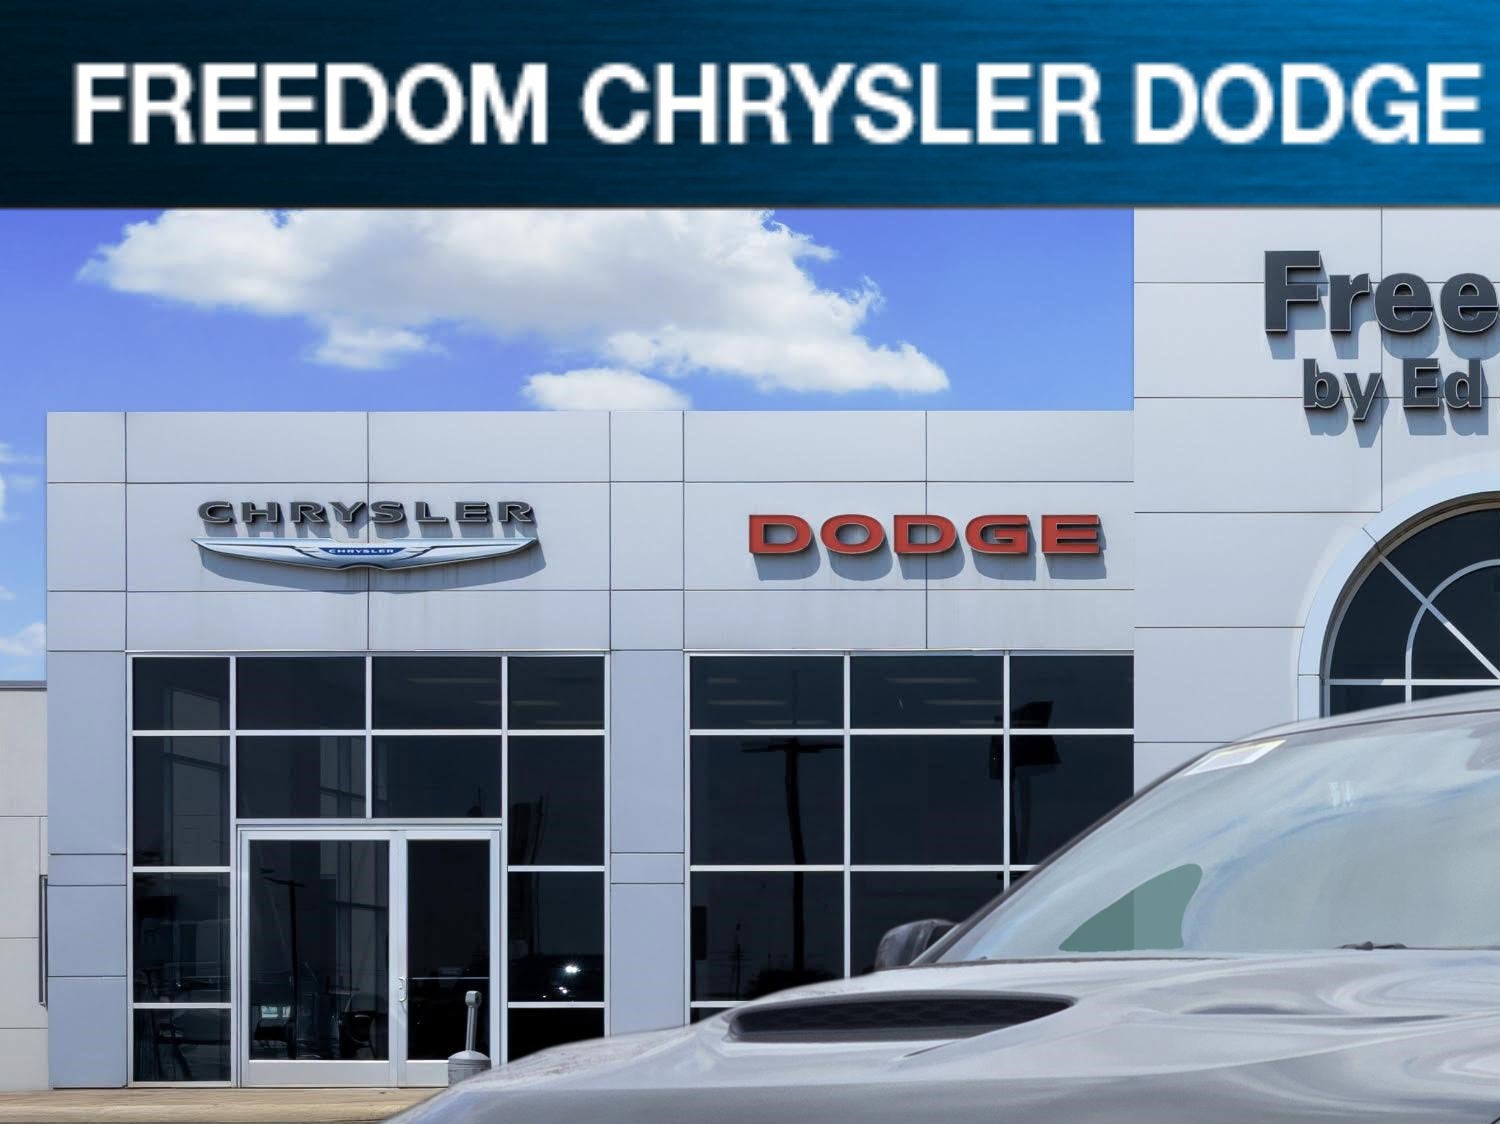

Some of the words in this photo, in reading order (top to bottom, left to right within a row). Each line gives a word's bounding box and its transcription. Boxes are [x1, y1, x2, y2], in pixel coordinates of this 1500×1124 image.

[1303, 358, 1382, 421] by
[1402, 358, 1483, 409] Ed
[198, 500, 535, 524] CHRYSLER
[748, 513, 1101, 554] DODGE
